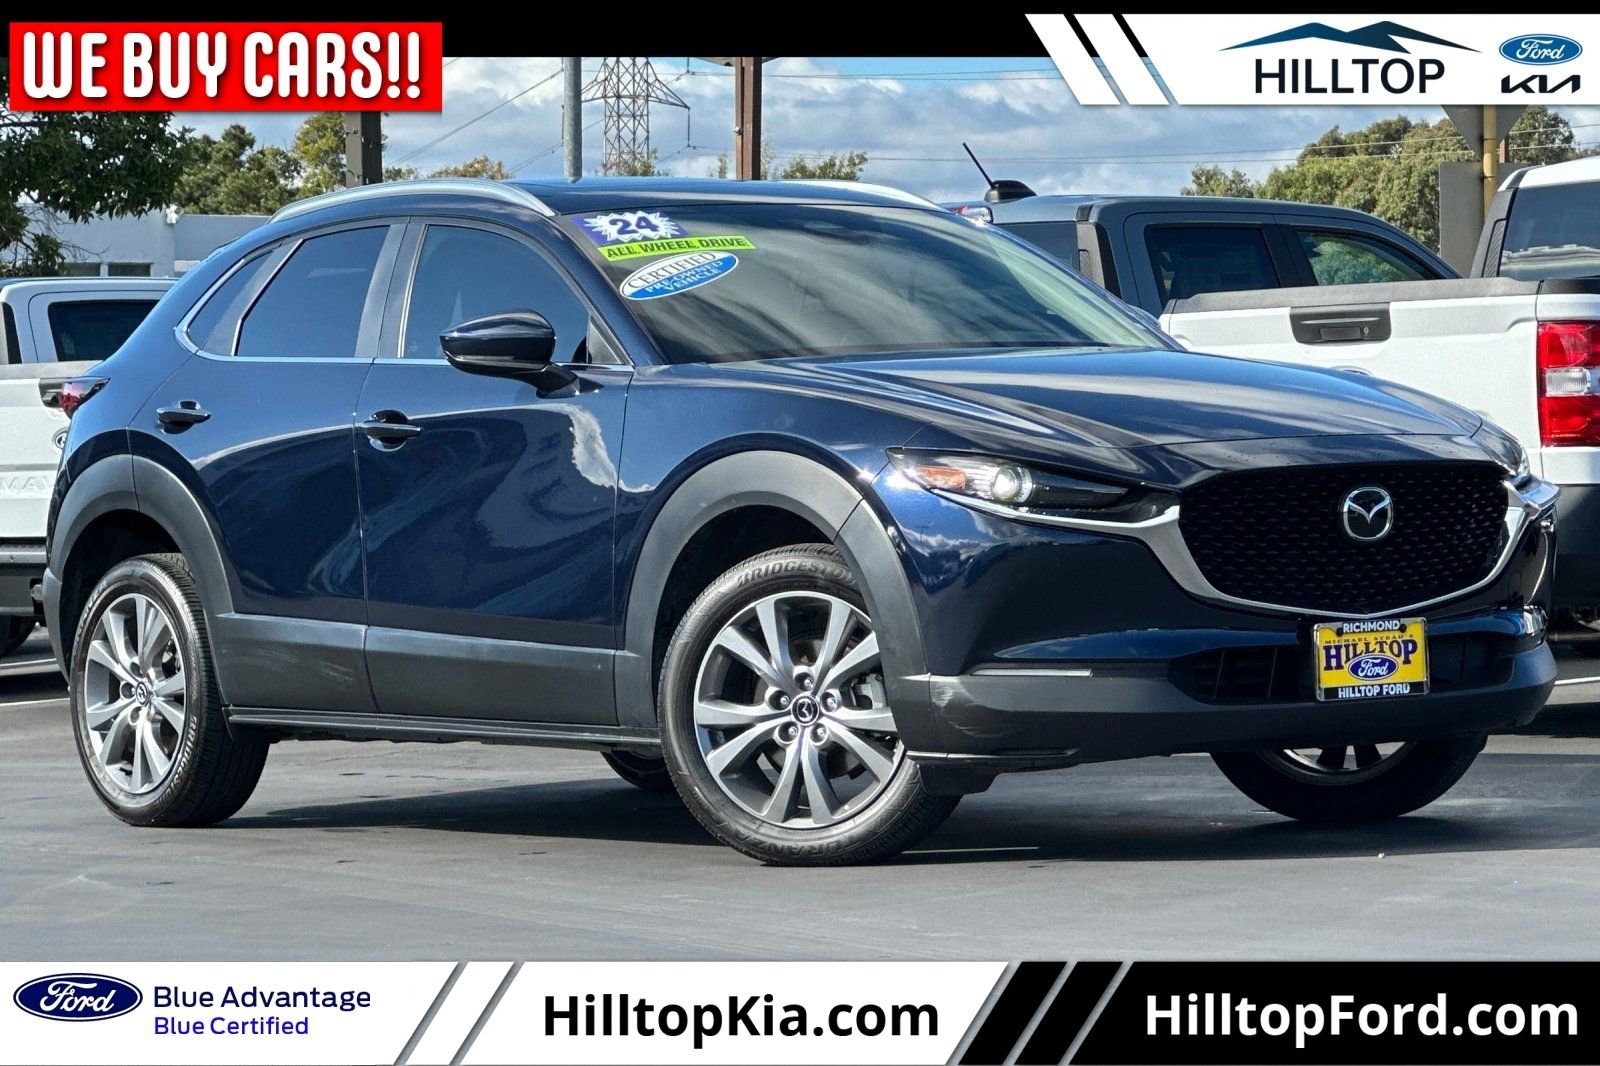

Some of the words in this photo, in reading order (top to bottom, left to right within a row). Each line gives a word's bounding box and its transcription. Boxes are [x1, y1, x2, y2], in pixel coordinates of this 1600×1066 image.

[608, 215, 659, 235] 24
[607, 247, 636, 258] ALL
[642, 240, 697, 253] WHEEL
[701, 237, 746, 248] DRIVE
[628, 251, 717, 289] CERTIFIED
[643, 260, 723, 293] PRE-OWNED
[662, 268, 722, 292] VEHICLE
[1343, 620, 1400, 633] RICHMOND
[1323, 638, 1418, 671] HILLTOP
[1358, 658, 1389, 677] Ford
[1338, 685, 1380, 698] HILLTOP
[1383, 683, 1410, 695] FORD
